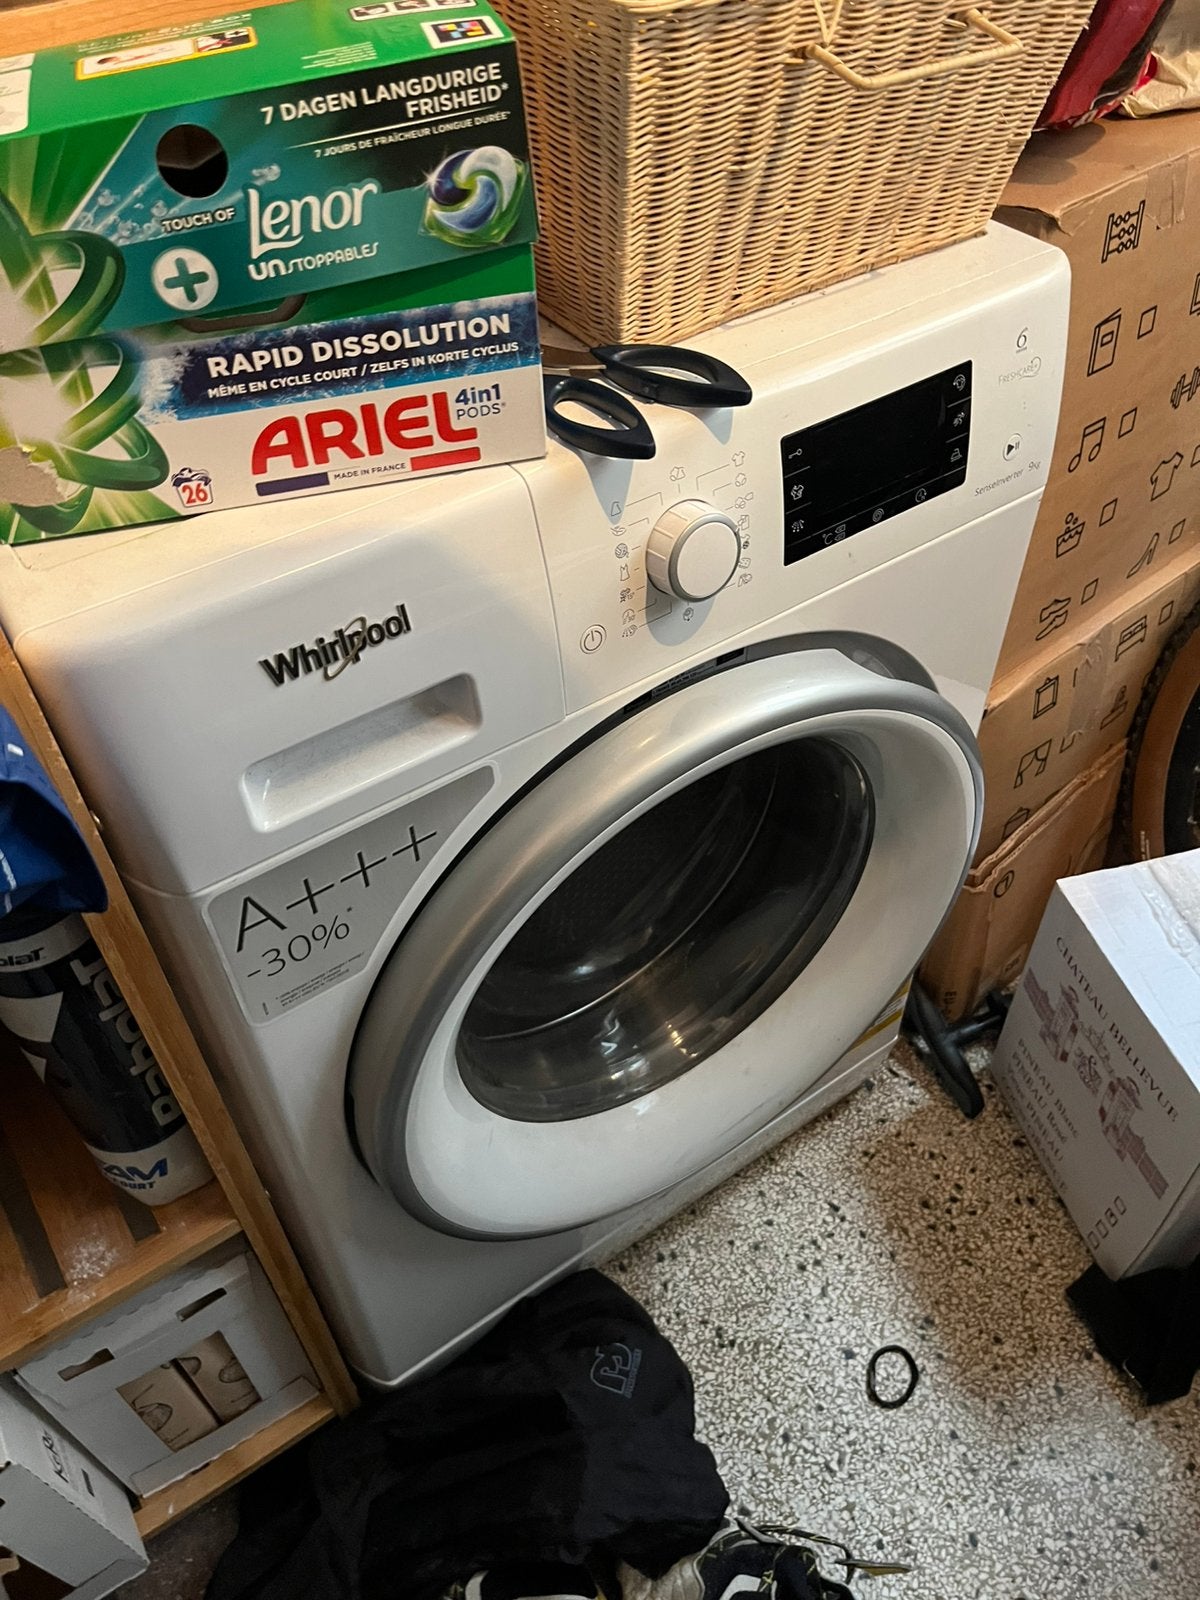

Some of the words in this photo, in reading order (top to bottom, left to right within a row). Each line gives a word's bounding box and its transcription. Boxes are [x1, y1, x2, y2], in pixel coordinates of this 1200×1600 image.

[261, 106, 274, 125] 7
[280, 90, 357, 121] DAGEN
[362, 62, 502, 105] LANGDURIGE
[314, 150, 322, 158] 7
[324, 144, 357, 156] JOURS
[358, 139, 373, 149] DE
[432, 118, 473, 134] LONGUE
[162, 216, 213, 233] TOUCH
[215, 208, 236, 222] OF
[248, 183, 378, 260] Lenor
[206, 342, 303, 378] RAPID
[311, 313, 511, 363] DISSOLUTION
[1016, 327, 1028, 348] 6
[208, 385, 246, 399] MÊME
[248, 380, 268, 392] EN
[270, 373, 312, 388] CYCLE
[314, 366, 358, 381] COURT
[361, 364, 368, 378] /
[371, 358, 409, 374] ZELFS
[412, 355, 425, 367] IN
[427, 349, 470, 365] KORTE
[471, 341, 519, 360] CYCLUS
[455, 383, 501, 406] 4in1
[251, 391, 478, 475] ARIEL
[182, 482, 208, 505] 26
[334, 471, 359, 480] MADE
[371, 462, 406, 475] FRANCE
[258, 603, 412, 688] Whirlpool
[237, 823, 437, 953] A+++
[1056, 936, 1109, 1021] CHATEAU
[1109, 1022, 1179, 1123] BELLEVUE
